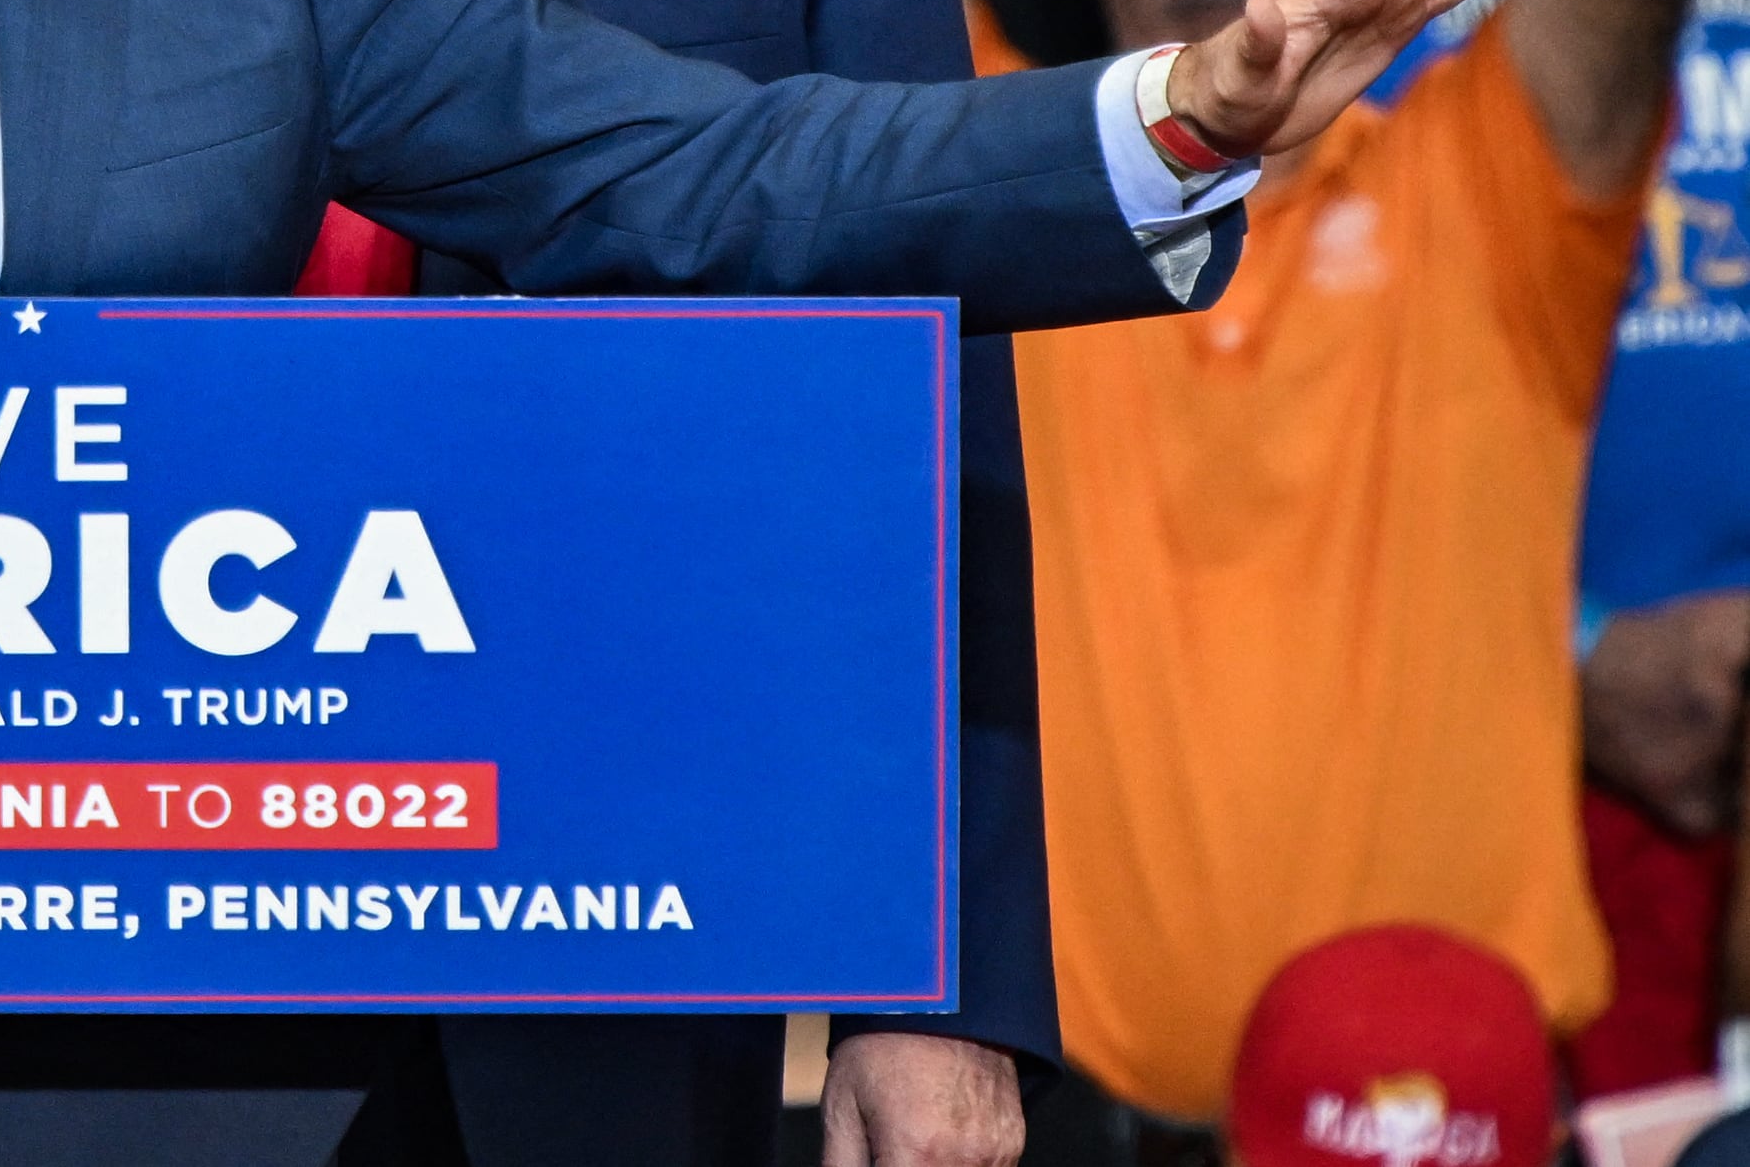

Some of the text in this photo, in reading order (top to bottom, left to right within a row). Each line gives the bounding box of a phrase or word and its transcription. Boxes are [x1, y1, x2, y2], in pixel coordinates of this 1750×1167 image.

[98, 689, 141, 727] J.
[161, 687, 350, 726] TRUMP
[146, 783, 233, 829] TO
[260, 783, 469, 829] 88022
[166, 883, 695, 932] PENNSYLVANIA
